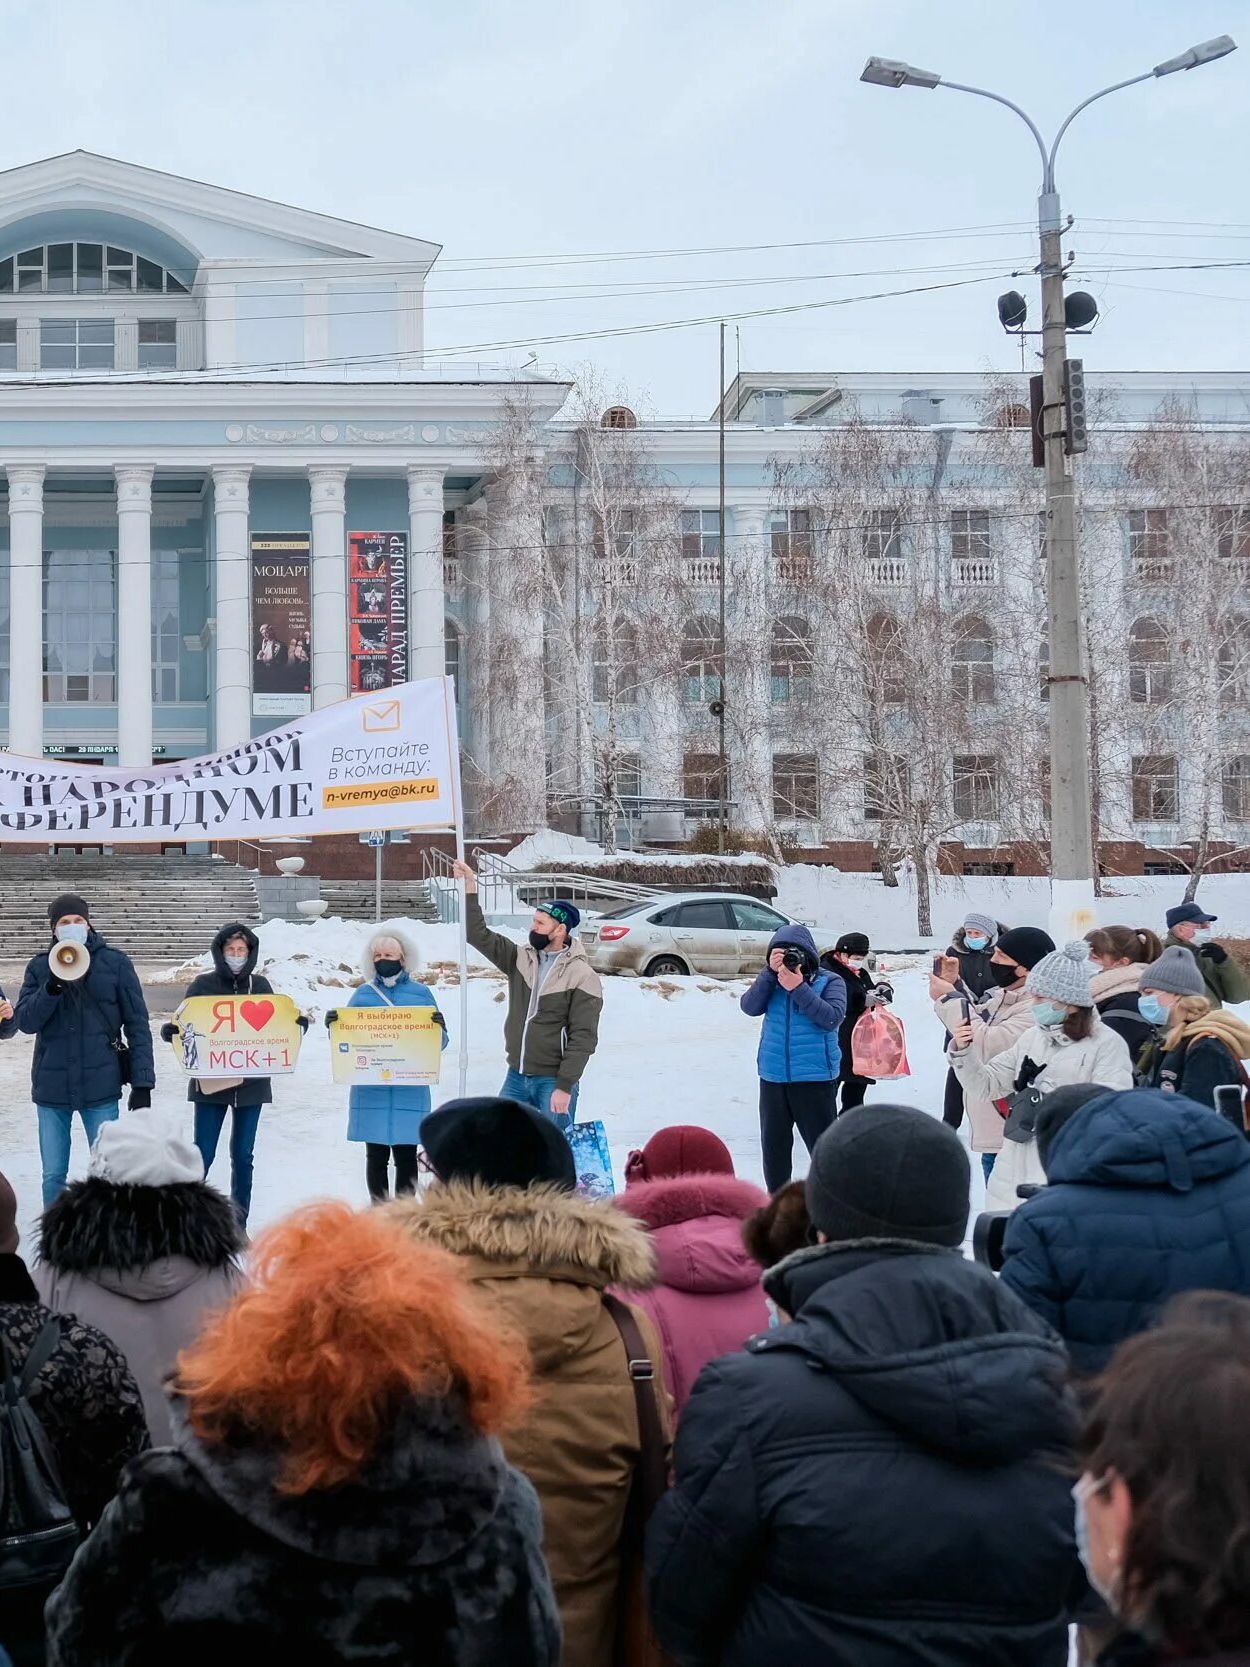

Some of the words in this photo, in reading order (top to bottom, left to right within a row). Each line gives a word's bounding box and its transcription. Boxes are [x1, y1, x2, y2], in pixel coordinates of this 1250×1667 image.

[254, 565, 309, 578] МОЦАРТ
[390, 536, 405, 624] ПРЕМЬЕР
[264, 587, 298, 595] БОЛЬШЕ
[331, 740, 429, 764] Вступайте
[328, 768, 338, 780] в
[344, 760, 431, 779] команду:
[326, 784, 436, 802] n-vremya@bk.ru
[209, 1000, 236, 1033] Я
[357, 1012, 364, 1020] Я
[366, 1011, 412, 1021] выбираю
[339, 1023, 403, 1031] Волгоградское
[404, 1022, 434, 1031] время!
[209, 1039, 265, 1047] Волгоградское
[370, 1032, 400, 1040] (МСК+1)
[209, 1049, 292, 1069] МСК+1
